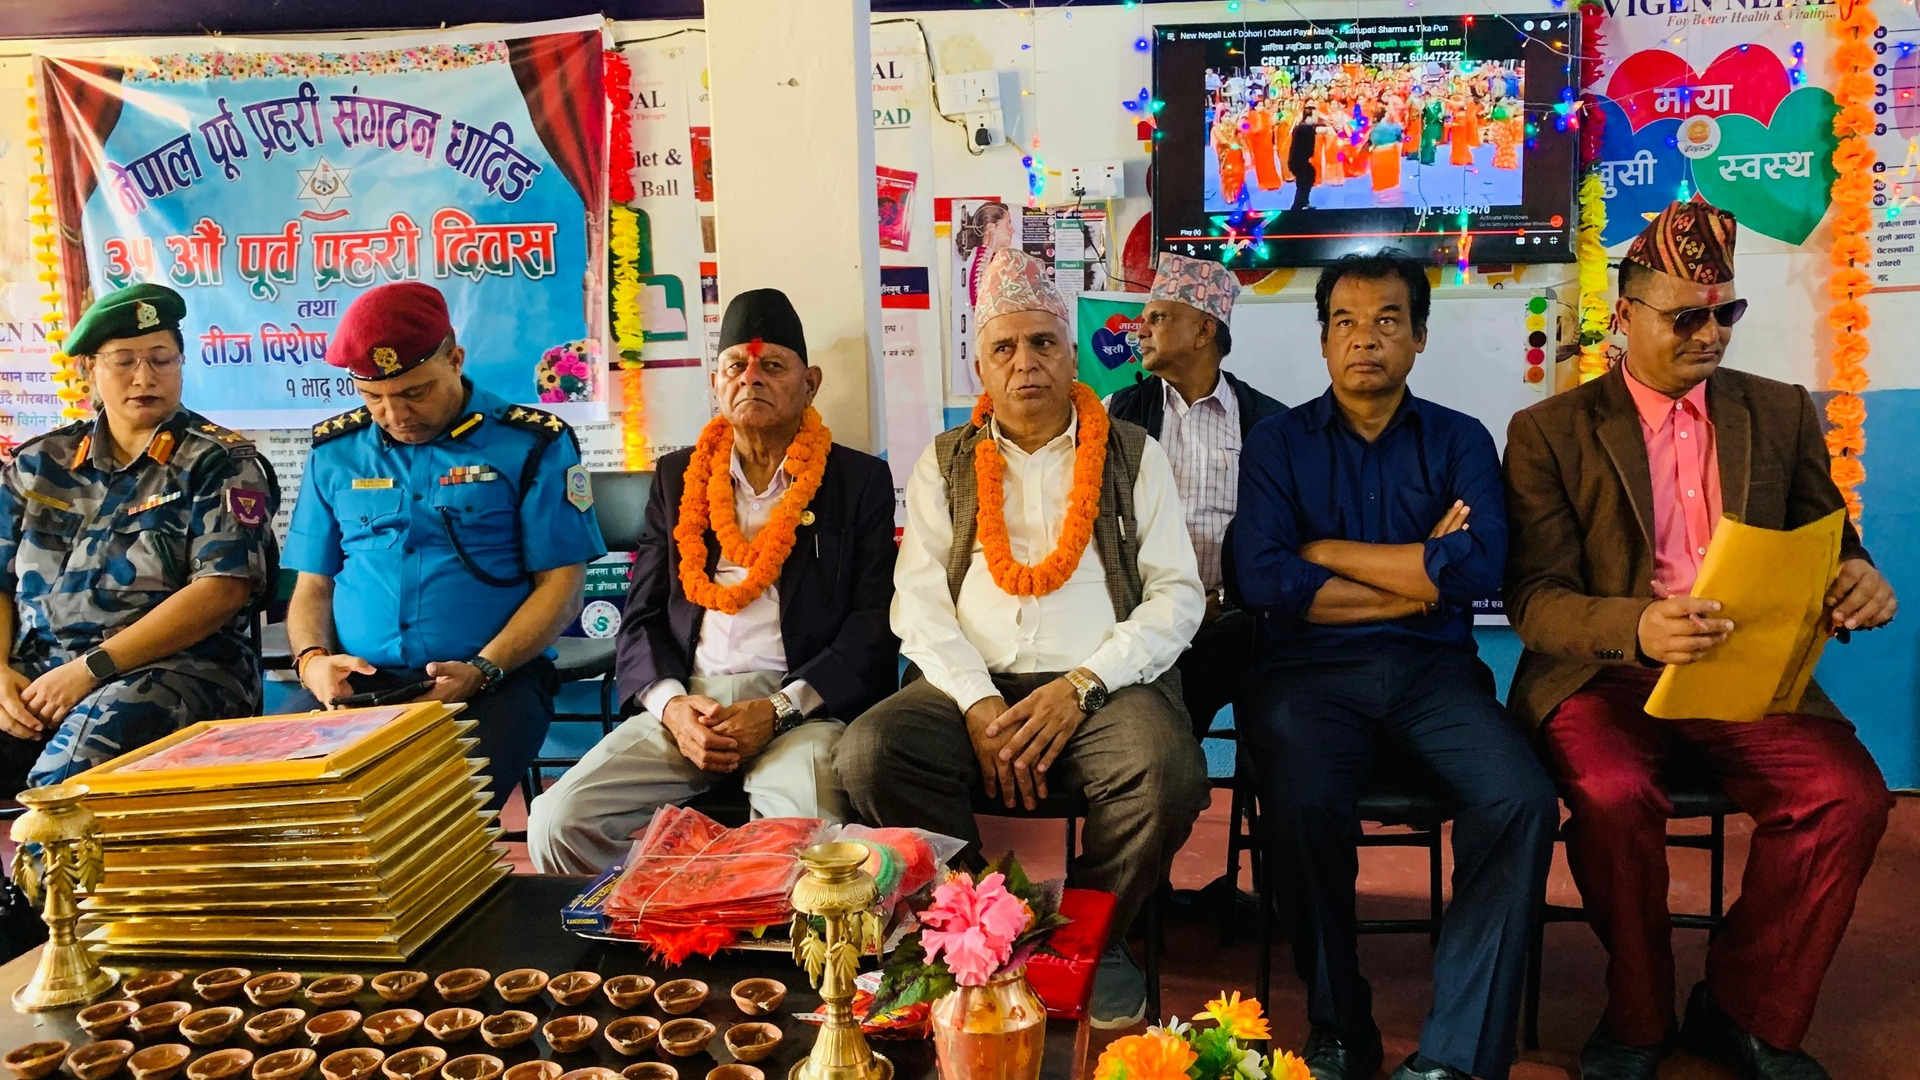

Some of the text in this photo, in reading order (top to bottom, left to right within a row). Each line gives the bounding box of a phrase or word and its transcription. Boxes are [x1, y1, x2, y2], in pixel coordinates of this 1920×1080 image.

[1667, 16, 1688, 27] For
[1692, 13, 1727, 25] Better
[1731, 11, 1769, 23] Health
[1774, 10, 1783, 21] &
[1180, 32, 1197, 40] New
[1198, 32, 1221, 40] Nepali
[1238, 30, 1262, 38] Dohori
[1268, 29, 1292, 37] Chhori
[1378, 25, 1407, 33] Sharma
[1408, 25, 1414, 33] &
[1416, 25, 1432, 33] Tka
[1260, 56, 1290, 66] CRBT
[1372, 52, 1400, 62] PRBT
[1410, 51, 1461, 62] 60447222
[1654, 84, 1734, 114] माया
[872, 108, 911, 126] PAD
[106, 132, 202, 217] नेपाल
[198, 98, 248, 180] पूर्व
[241, 81, 324, 160] प्रहरी
[330, 85, 442, 160] संगठन
[632, 148, 682, 168] let &
[1717, 151, 1815, 182] स्वस्थ
[641, 179, 679, 198] Ball
[236, 219, 302, 302] पूर्व
[311, 211, 421, 291] प्रहरी
[432, 207, 558, 283] दिवस
[297, 299, 337, 319] तथा
[199, 322, 329, 367] तीज विशेष
[1102, 344, 1124, 355] खुसी
[25, 372, 46, 382] बाट
[286, 379, 296, 398] १
[336, 377, 357, 397] २०
[17, 411, 47, 426] विगेन
